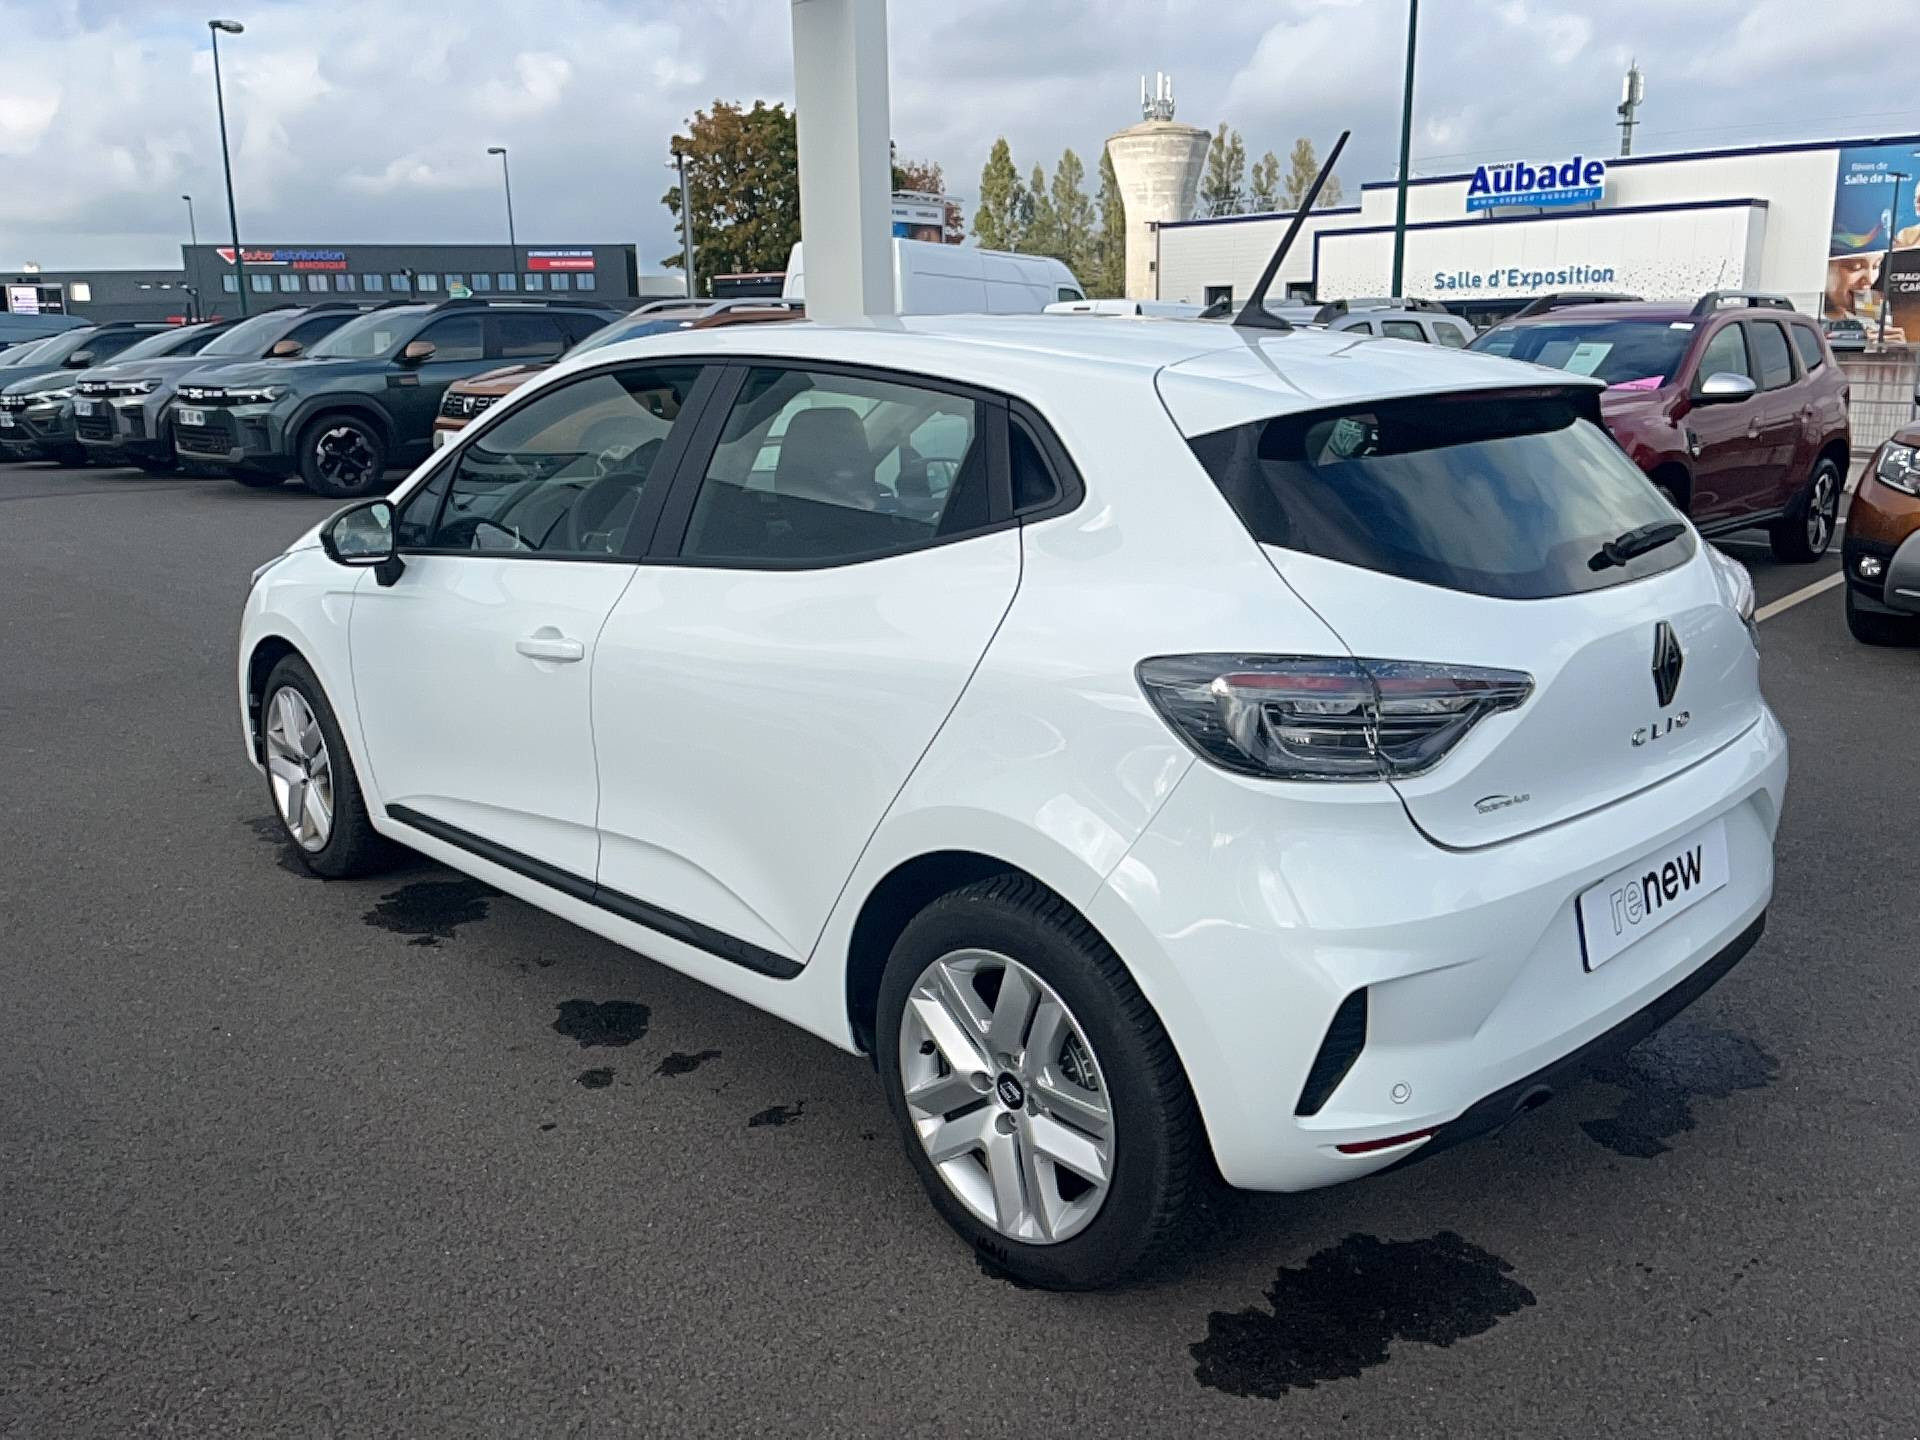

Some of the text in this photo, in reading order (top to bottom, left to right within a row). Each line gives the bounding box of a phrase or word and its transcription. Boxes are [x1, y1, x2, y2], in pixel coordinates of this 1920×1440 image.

[1467, 155, 1605, 196] Aubade
[1844, 173, 1869, 185] Salle
[1869, 173, 1883, 184] de
[1472, 188, 1596, 206] www.espace-aubade.fr
[1434, 265, 1615, 290] Salle d'Exposition
[1631, 710, 1690, 748] CLIO
[1609, 844, 1702, 936] renew
